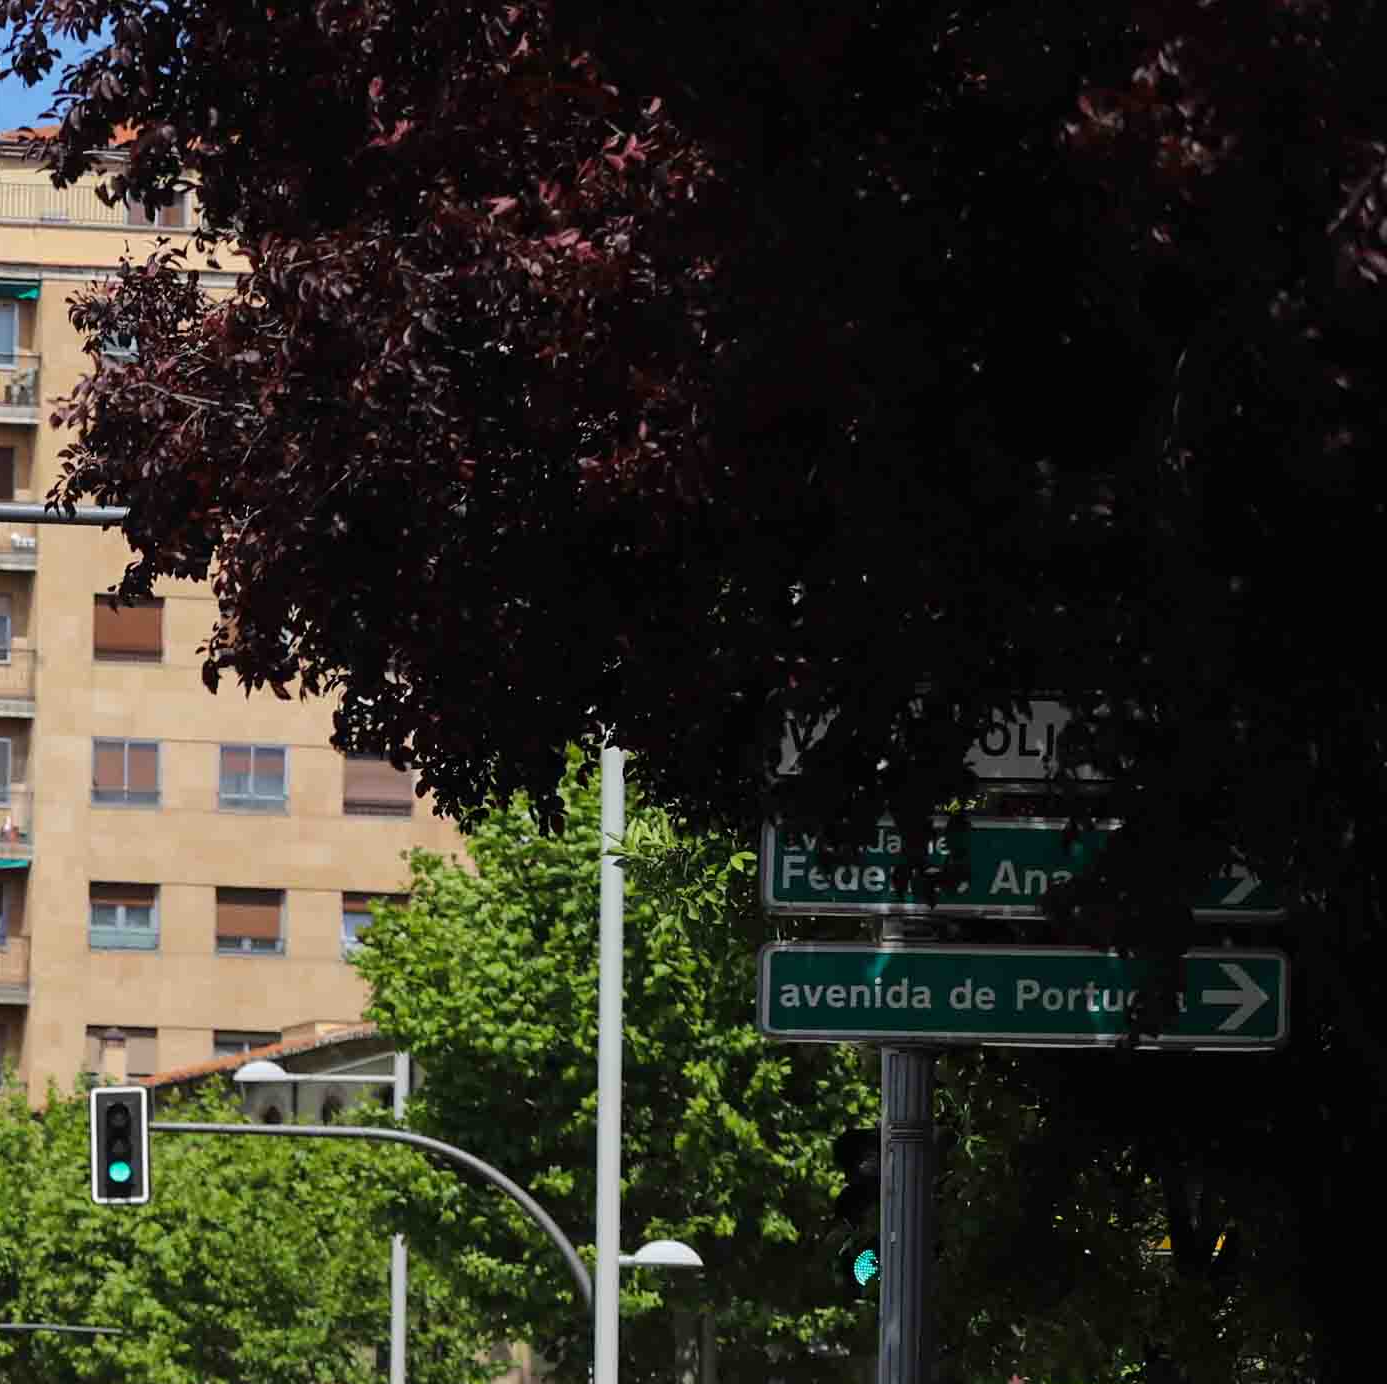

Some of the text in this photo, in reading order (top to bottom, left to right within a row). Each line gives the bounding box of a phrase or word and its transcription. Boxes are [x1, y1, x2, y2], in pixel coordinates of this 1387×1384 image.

[778, 976, 1188, 1016] avenida de Portul
